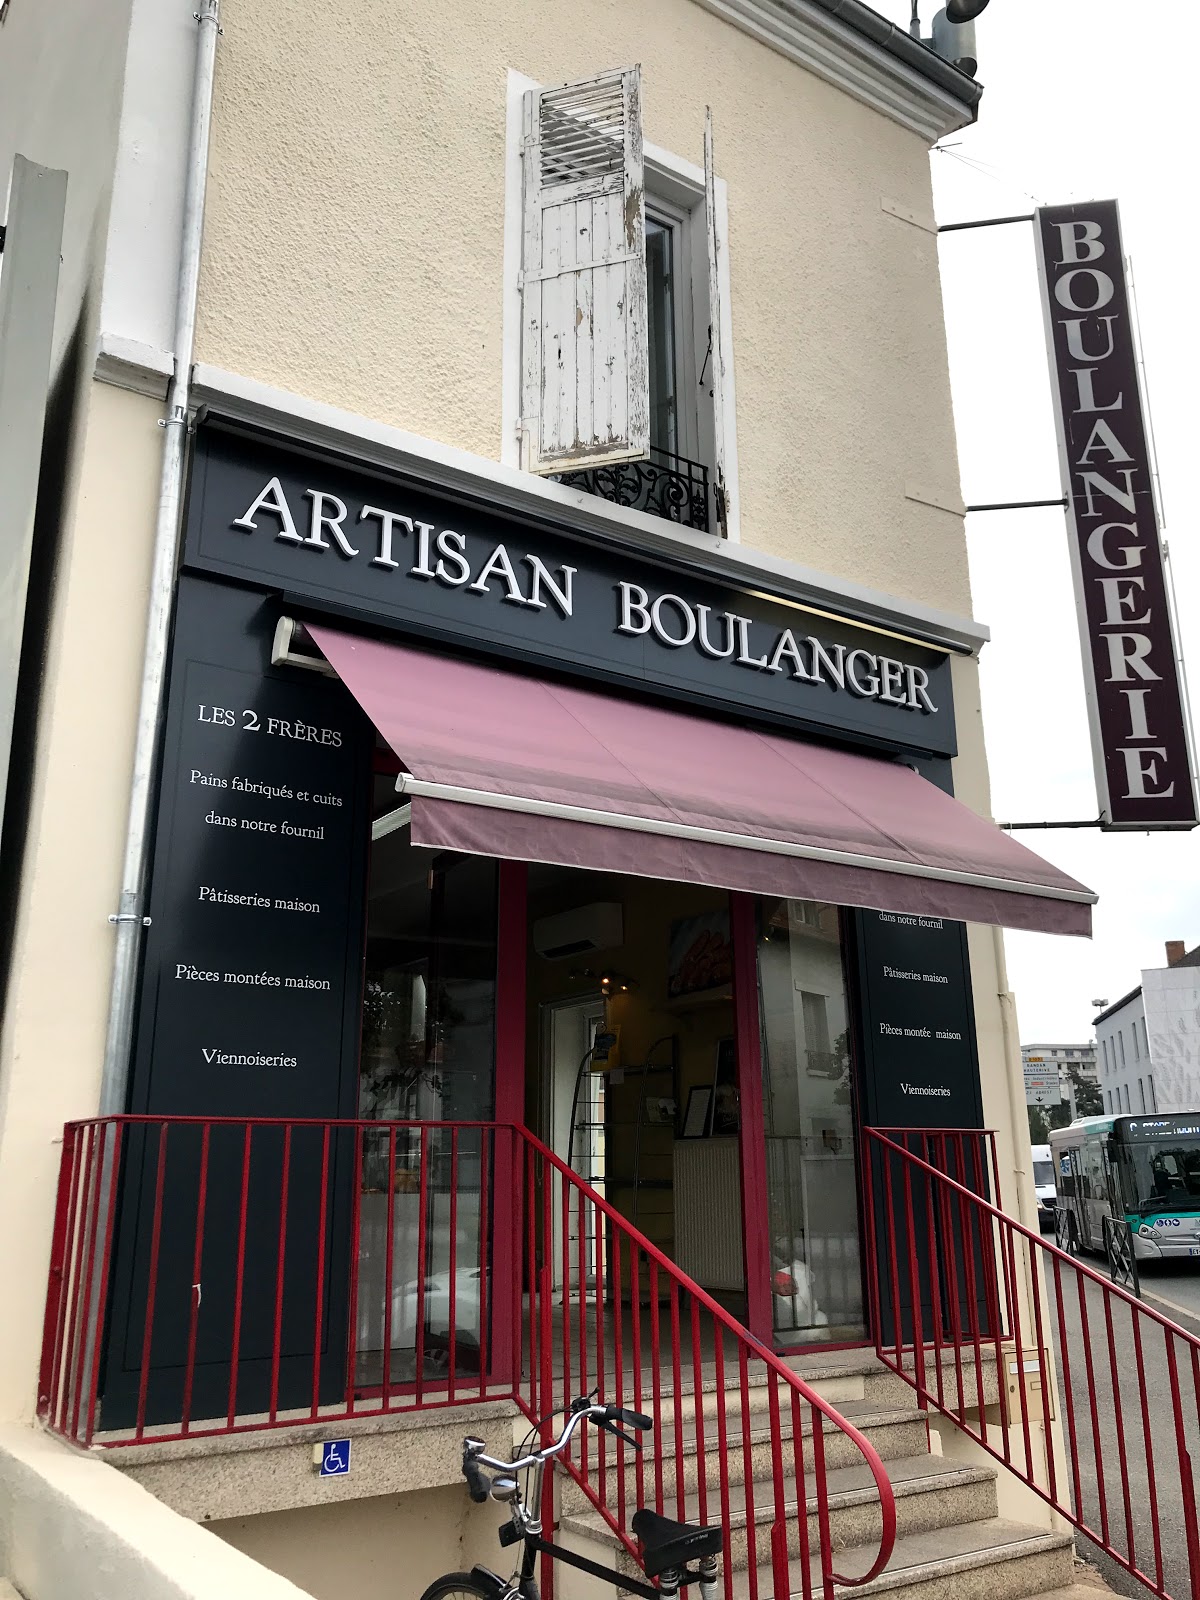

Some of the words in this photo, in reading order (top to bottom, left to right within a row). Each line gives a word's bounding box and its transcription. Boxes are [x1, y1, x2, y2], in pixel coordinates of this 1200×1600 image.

[1050, 219, 1176, 800] BOULANGERIE
[233, 476, 577, 616] ARTISAN
[615, 580, 939, 714] BOULANGER
[197, 704, 236, 727] LES
[242, 709, 261, 732] 2
[266, 718, 343, 748] FRÈRES
[189, 769, 228, 789] Pains
[231, 776, 293, 799] fabriqués
[296, 791, 310, 802] et
[313, 792, 343, 807] cuits
[205, 810, 237, 828] dans
[240, 817, 277, 833] notre
[280, 821, 325, 840] fournil
[198, 886, 271, 908] Pâtisseries
[274, 897, 321, 913] maison
[878, 911, 896, 923] dans
[897, 914, 917, 926] notre
[918, 916, 944, 930] fournil
[174, 964, 220, 982] Pièces
[223, 971, 281, 987] montées
[284, 975, 331, 990] maison
[883, 965, 921, 982] Pâtisseries
[922, 970, 949, 984] maison
[879, 1022, 903, 1036] Pièces
[904, 1026, 932, 1038] montée
[935, 1028, 962, 1040] maison
[201, 1048, 298, 1068] Viennoiseries
[900, 1082, 951, 1097] Viennoiseries
